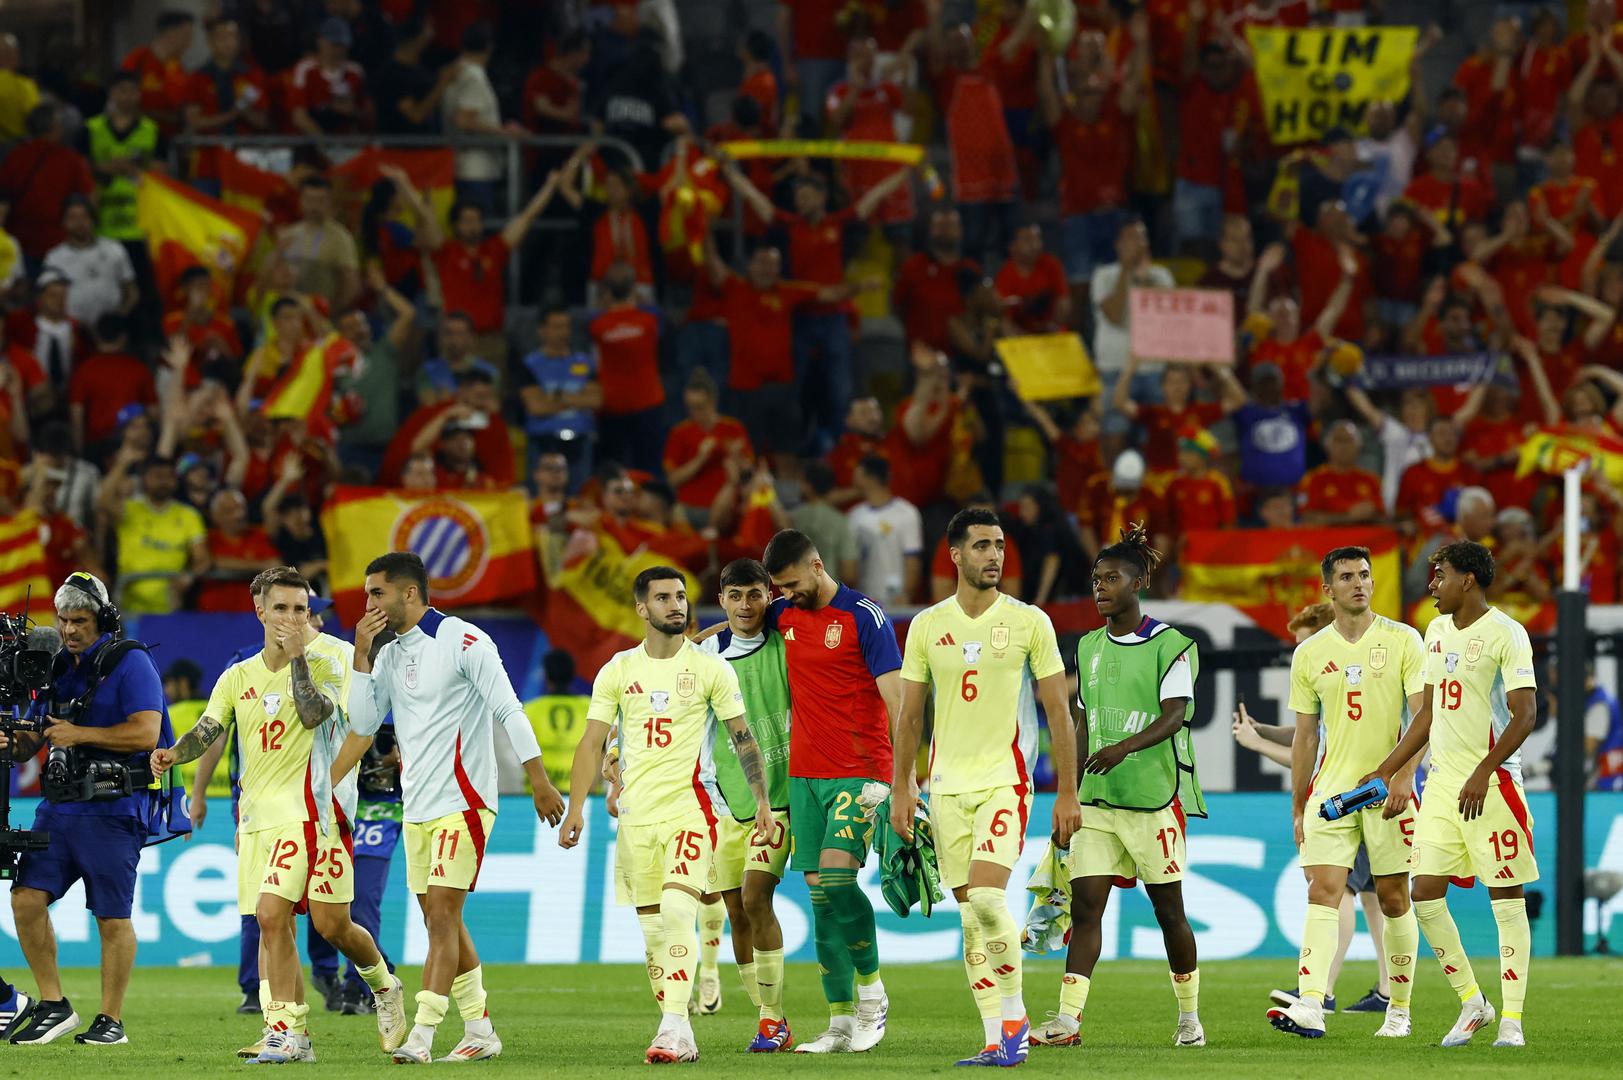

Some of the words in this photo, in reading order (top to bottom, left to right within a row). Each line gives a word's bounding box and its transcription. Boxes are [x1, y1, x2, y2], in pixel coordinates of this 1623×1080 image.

[1285, 33, 1380, 68] LIM
[961, 670, 978, 702] 6
[1439, 678, 1462, 710] 19
[1347, 691, 1362, 721] 5
[259, 720, 286, 752] 12
[643, 718, 672, 748] 15
[354, 823, 383, 847] 26
[990, 809, 1012, 837] 6
[1399, 818, 1414, 847] 5
[269, 839, 298, 870] 12
[437, 829, 459, 860] 11
[675, 830, 703, 861] 15
[1156, 827, 1177, 859] 17
[1488, 829, 1519, 862] 19
[312, 848, 343, 879] 25
